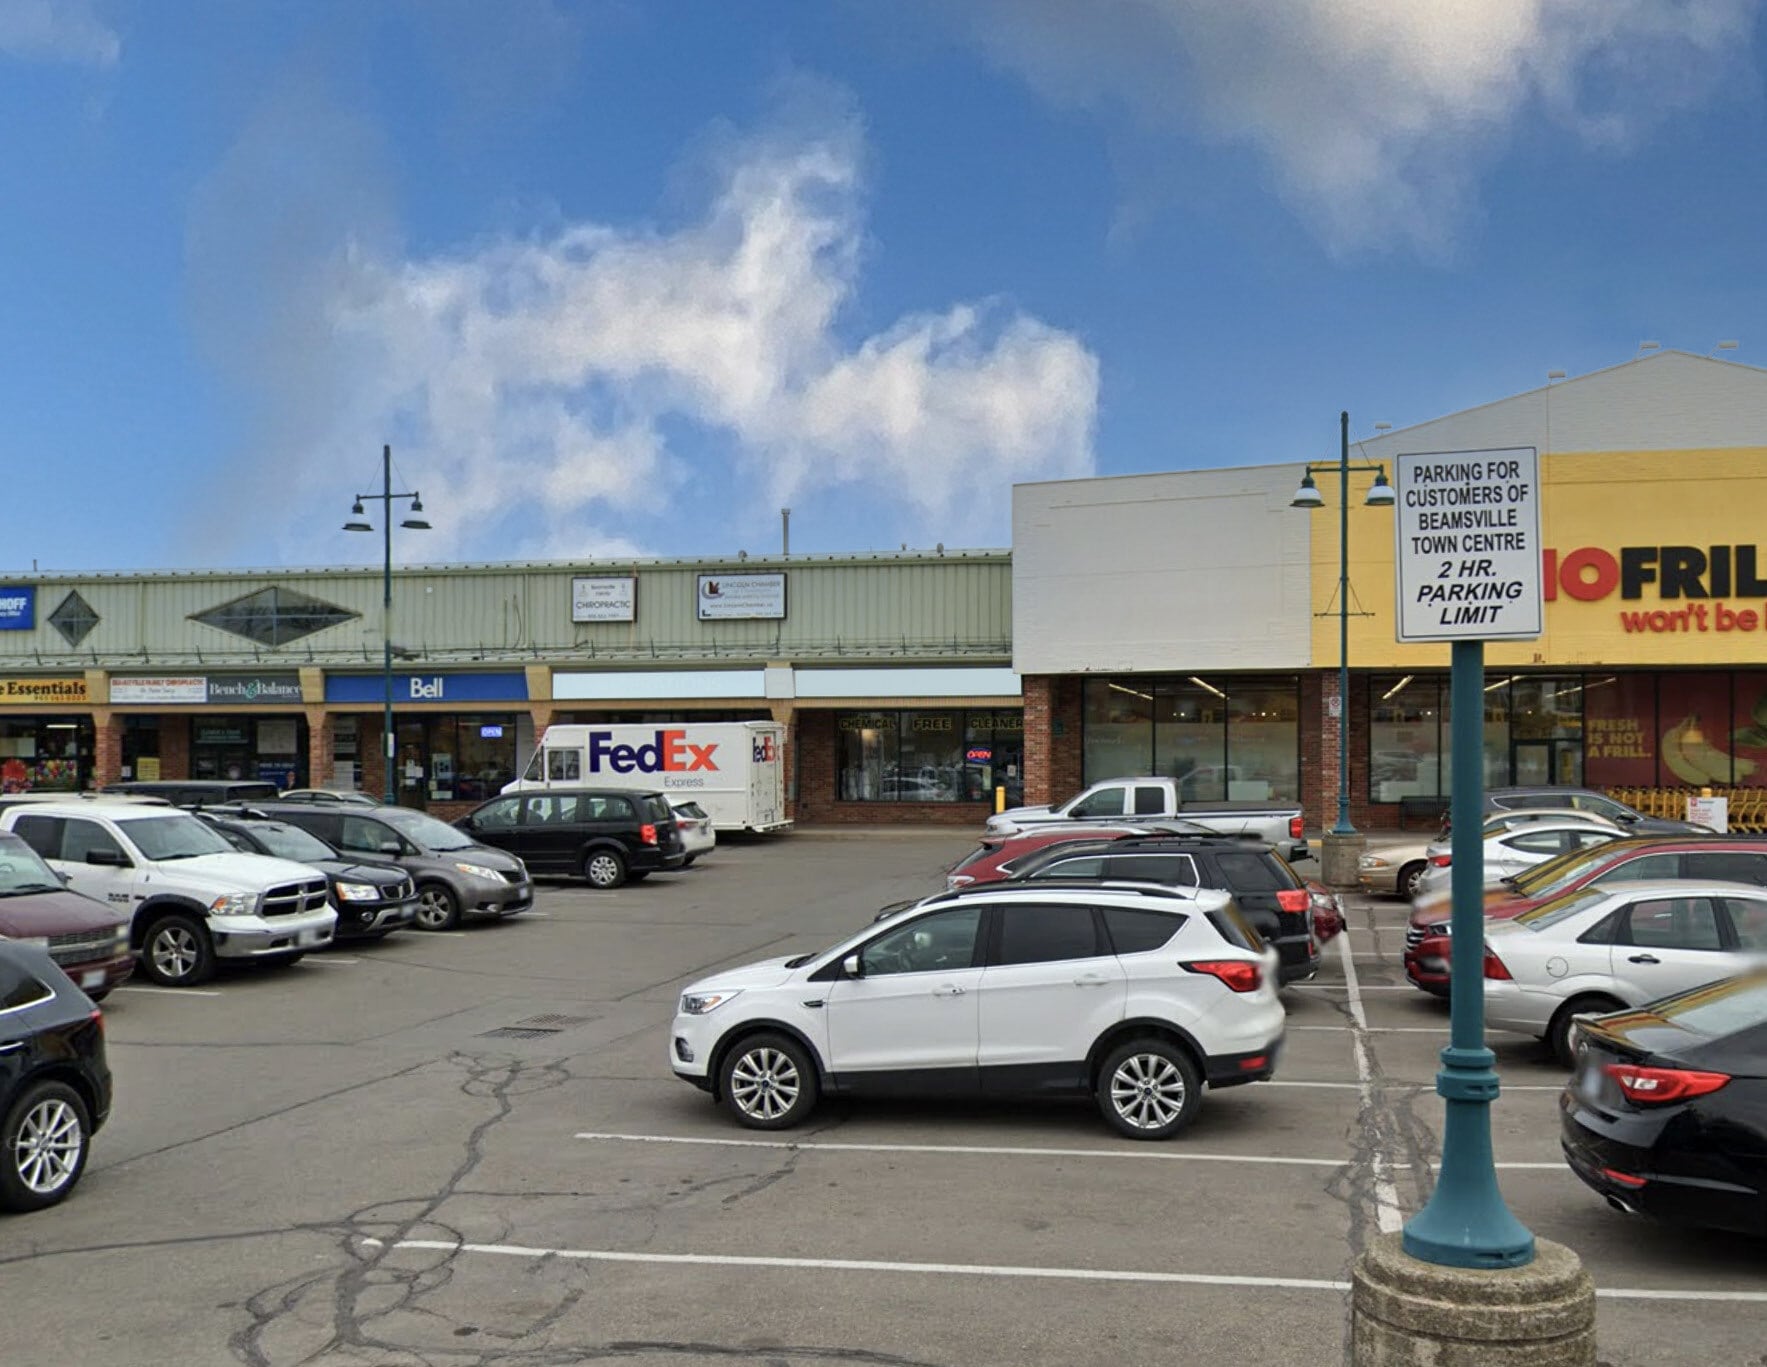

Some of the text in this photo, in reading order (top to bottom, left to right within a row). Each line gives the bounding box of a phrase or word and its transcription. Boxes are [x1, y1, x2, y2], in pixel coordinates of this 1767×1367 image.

[1414, 461, 1520, 484] PARKING FOR
[1406, 484, 1529, 508] CUSTOMERS OF
[1419, 509, 1517, 531] BEAMSVILLE
[1412, 532, 1526, 554] TOWN CENTRE
[1438, 559, 1497, 578] 2 HR.
[1417, 581, 1523, 603] PARKING
[576, 600, 631, 609] CHIROPRACTIC
[1440, 605, 1503, 624] LIMIT
[1620, 602, 1759, 633] won't be
[8, 681, 87, 695] Essentials
[410, 677, 443, 698] Bell
[481, 727, 503, 737] OPEN
[913, 719, 952, 730] FREE
[1588, 719, 1639, 731] FRESH
[1588, 732, 1645, 745] IS NOT
[589, 730, 720, 773] FedEx
[966, 750, 992, 760] OPEN
[1588, 746, 1600, 757] A
[664, 776, 704, 788] Express
